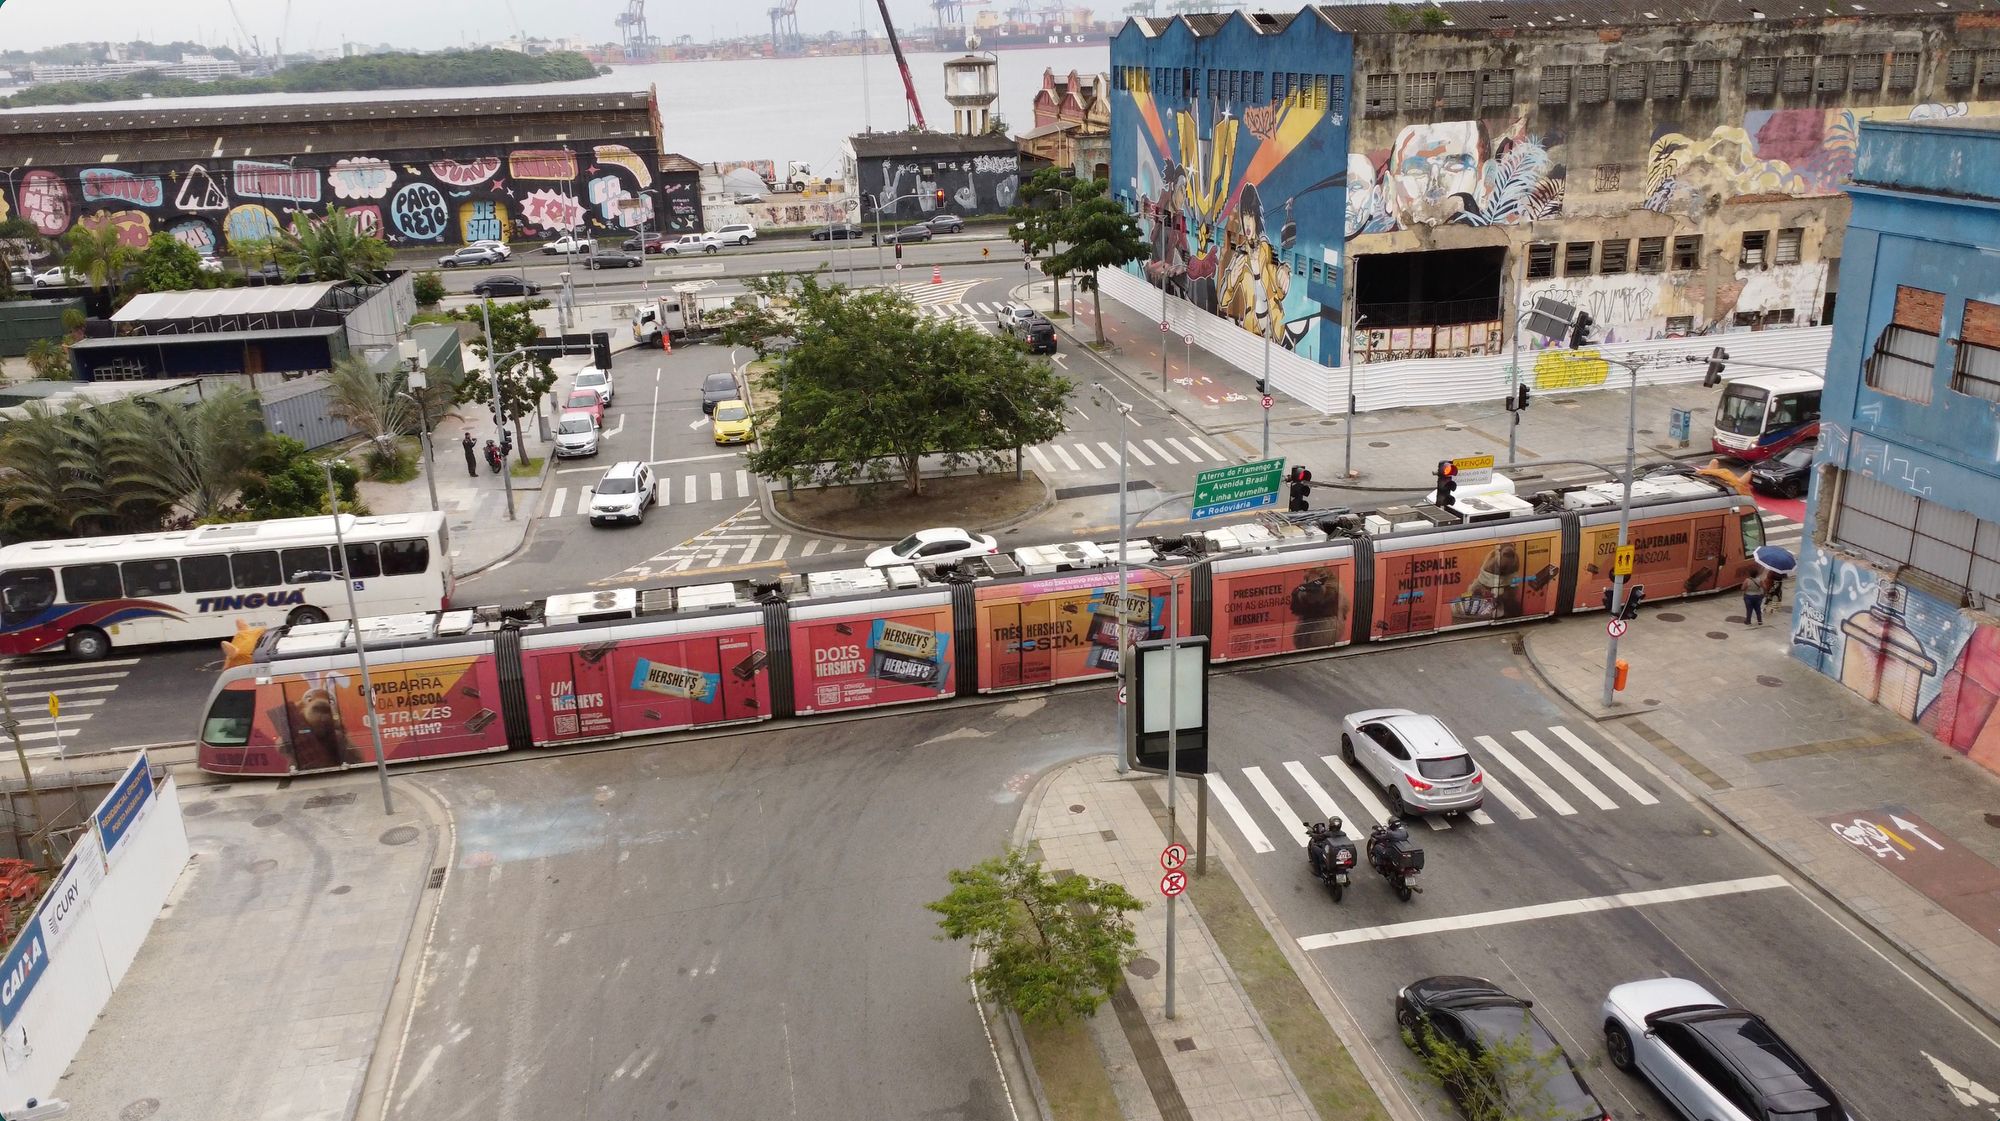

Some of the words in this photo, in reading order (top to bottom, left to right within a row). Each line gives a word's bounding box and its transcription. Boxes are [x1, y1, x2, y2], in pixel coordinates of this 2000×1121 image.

[396, 186, 440, 214] PAPO
[472, 200, 496, 219] DE
[530, 197, 577, 225] TOP
[400, 206, 445, 236] RETO
[466, 220, 501, 240] BOA
[1200, 472, 1225, 482] Aterro
[1237, 463, 1272, 475] Flamengo
[1212, 479, 1244, 491] Avenida
[1245, 474, 1269, 485] Brasil
[1209, 492, 1232, 503] Linha
[1234, 486, 1269, 498] Vermelha
[1208, 501, 1251, 515] Rodoviária
[1598, 542, 1617, 555] SIG
[1414, 556, 1458, 573] ESPALHE
[1398, 575, 1432, 591] MUITO
[1434, 572, 1461, 586] MAIS
[196, 588, 305, 613] TINGUÁ
[1225, 601, 1243, 613] COM
[1245, 600, 1256, 610] AS
[1258, 595, 1291, 608] BARRAS
[883, 627, 929, 649] HERSHEY'S
[993, 623, 1022, 641] TRÊS
[1026, 620, 1072, 638] HERSHEY'S
[814, 645, 860, 663] DOIS
[815, 659, 866, 678] HERSHEY'S
[883, 657, 930, 679] HERSHEY'S
[358, 677, 443, 697] CPIBARRA
[551, 681, 572, 696] UM
[649, 668, 698, 690] HERSHEY'S
[378, 697, 394, 710] DA
[552, 693, 604, 711] HERSHEY'S
[362, 713, 387, 728] QE
[389, 706, 452, 723] TRAZES
[383, 726, 408, 738] PRA
[409, 722, 442, 737] MIM?
[56, 878, 79, 921] CURY
[2, 936, 42, 1006] CAIXA
